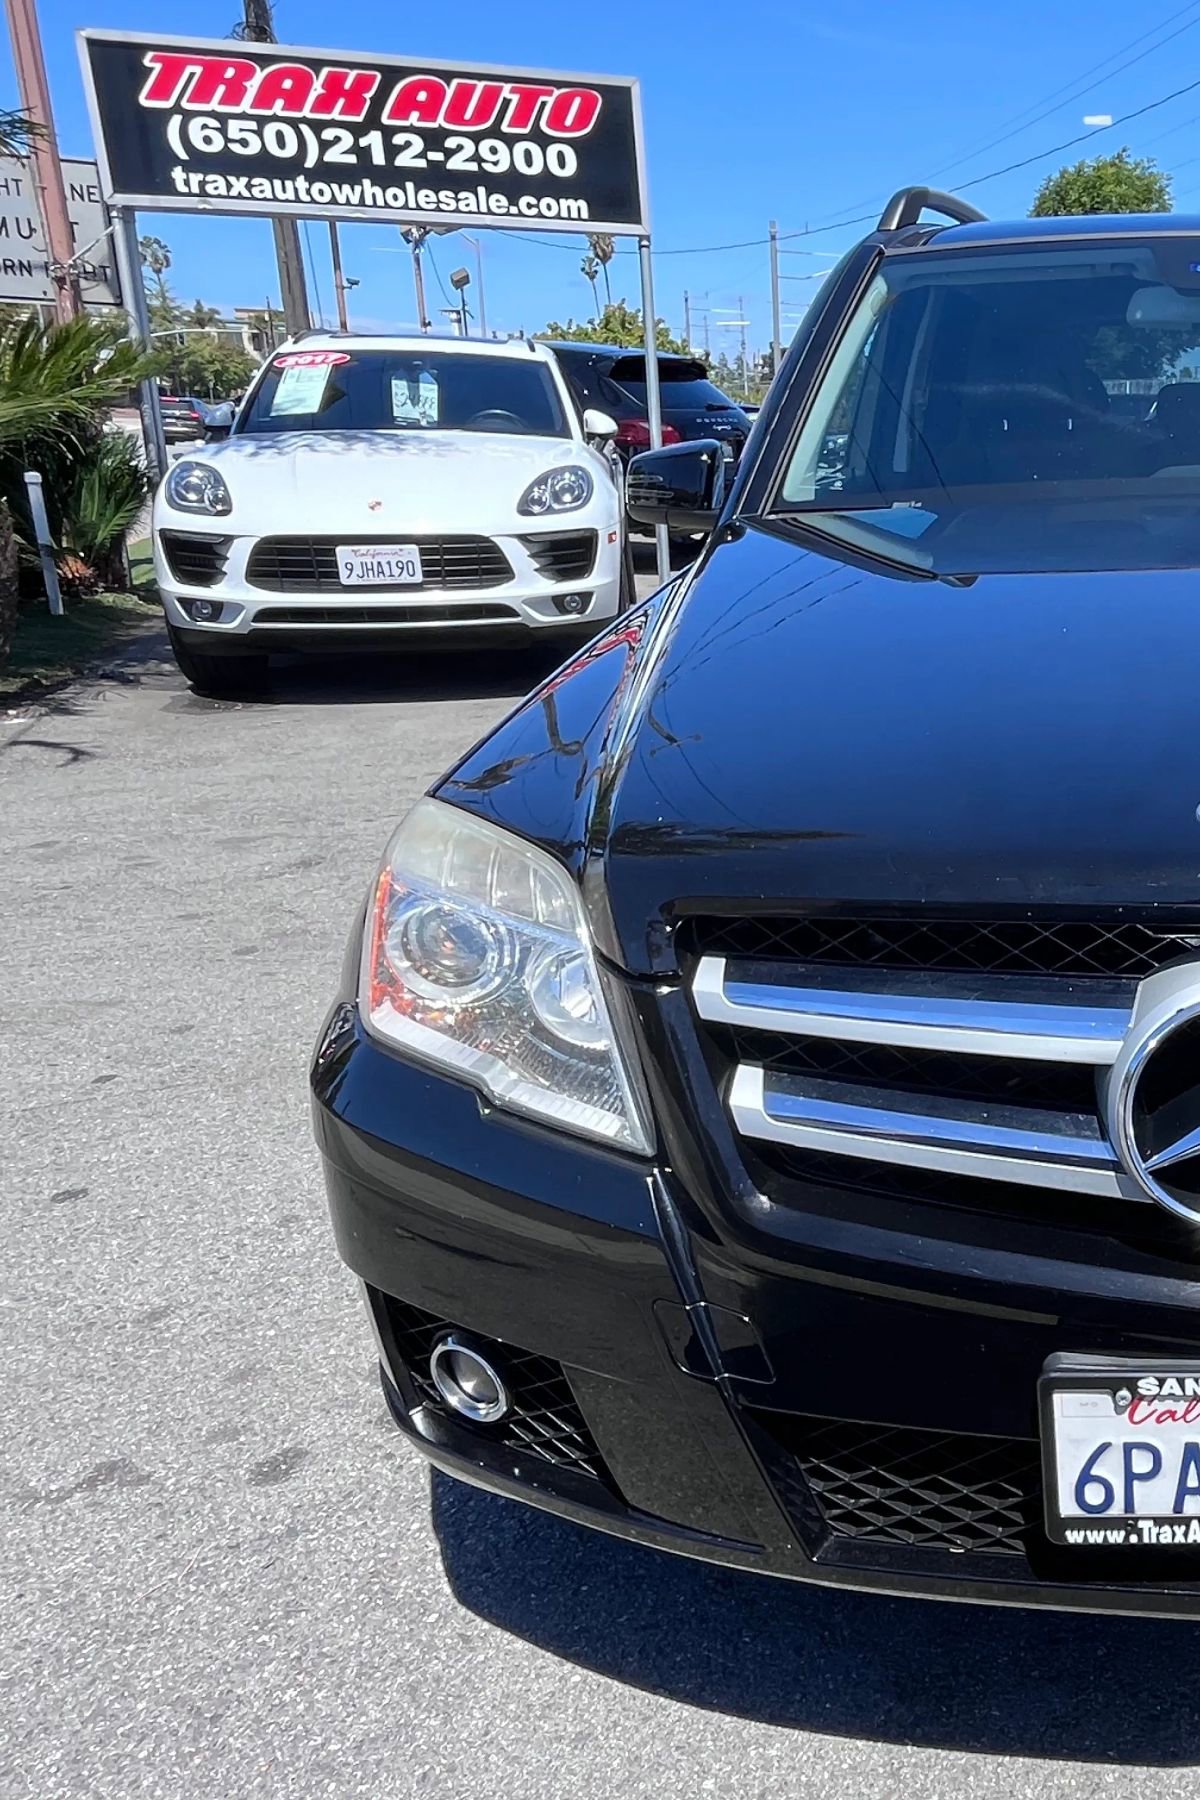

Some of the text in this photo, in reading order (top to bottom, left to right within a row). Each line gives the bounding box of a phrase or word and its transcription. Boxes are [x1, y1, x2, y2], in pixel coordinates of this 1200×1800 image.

[139, 51, 602, 138] TRAX AUTO
[167, 114, 577, 178] (650)212-2900
[171, 165, 589, 219] traxautowholesale.com
[344, 560, 416, 579] 9JHA190
